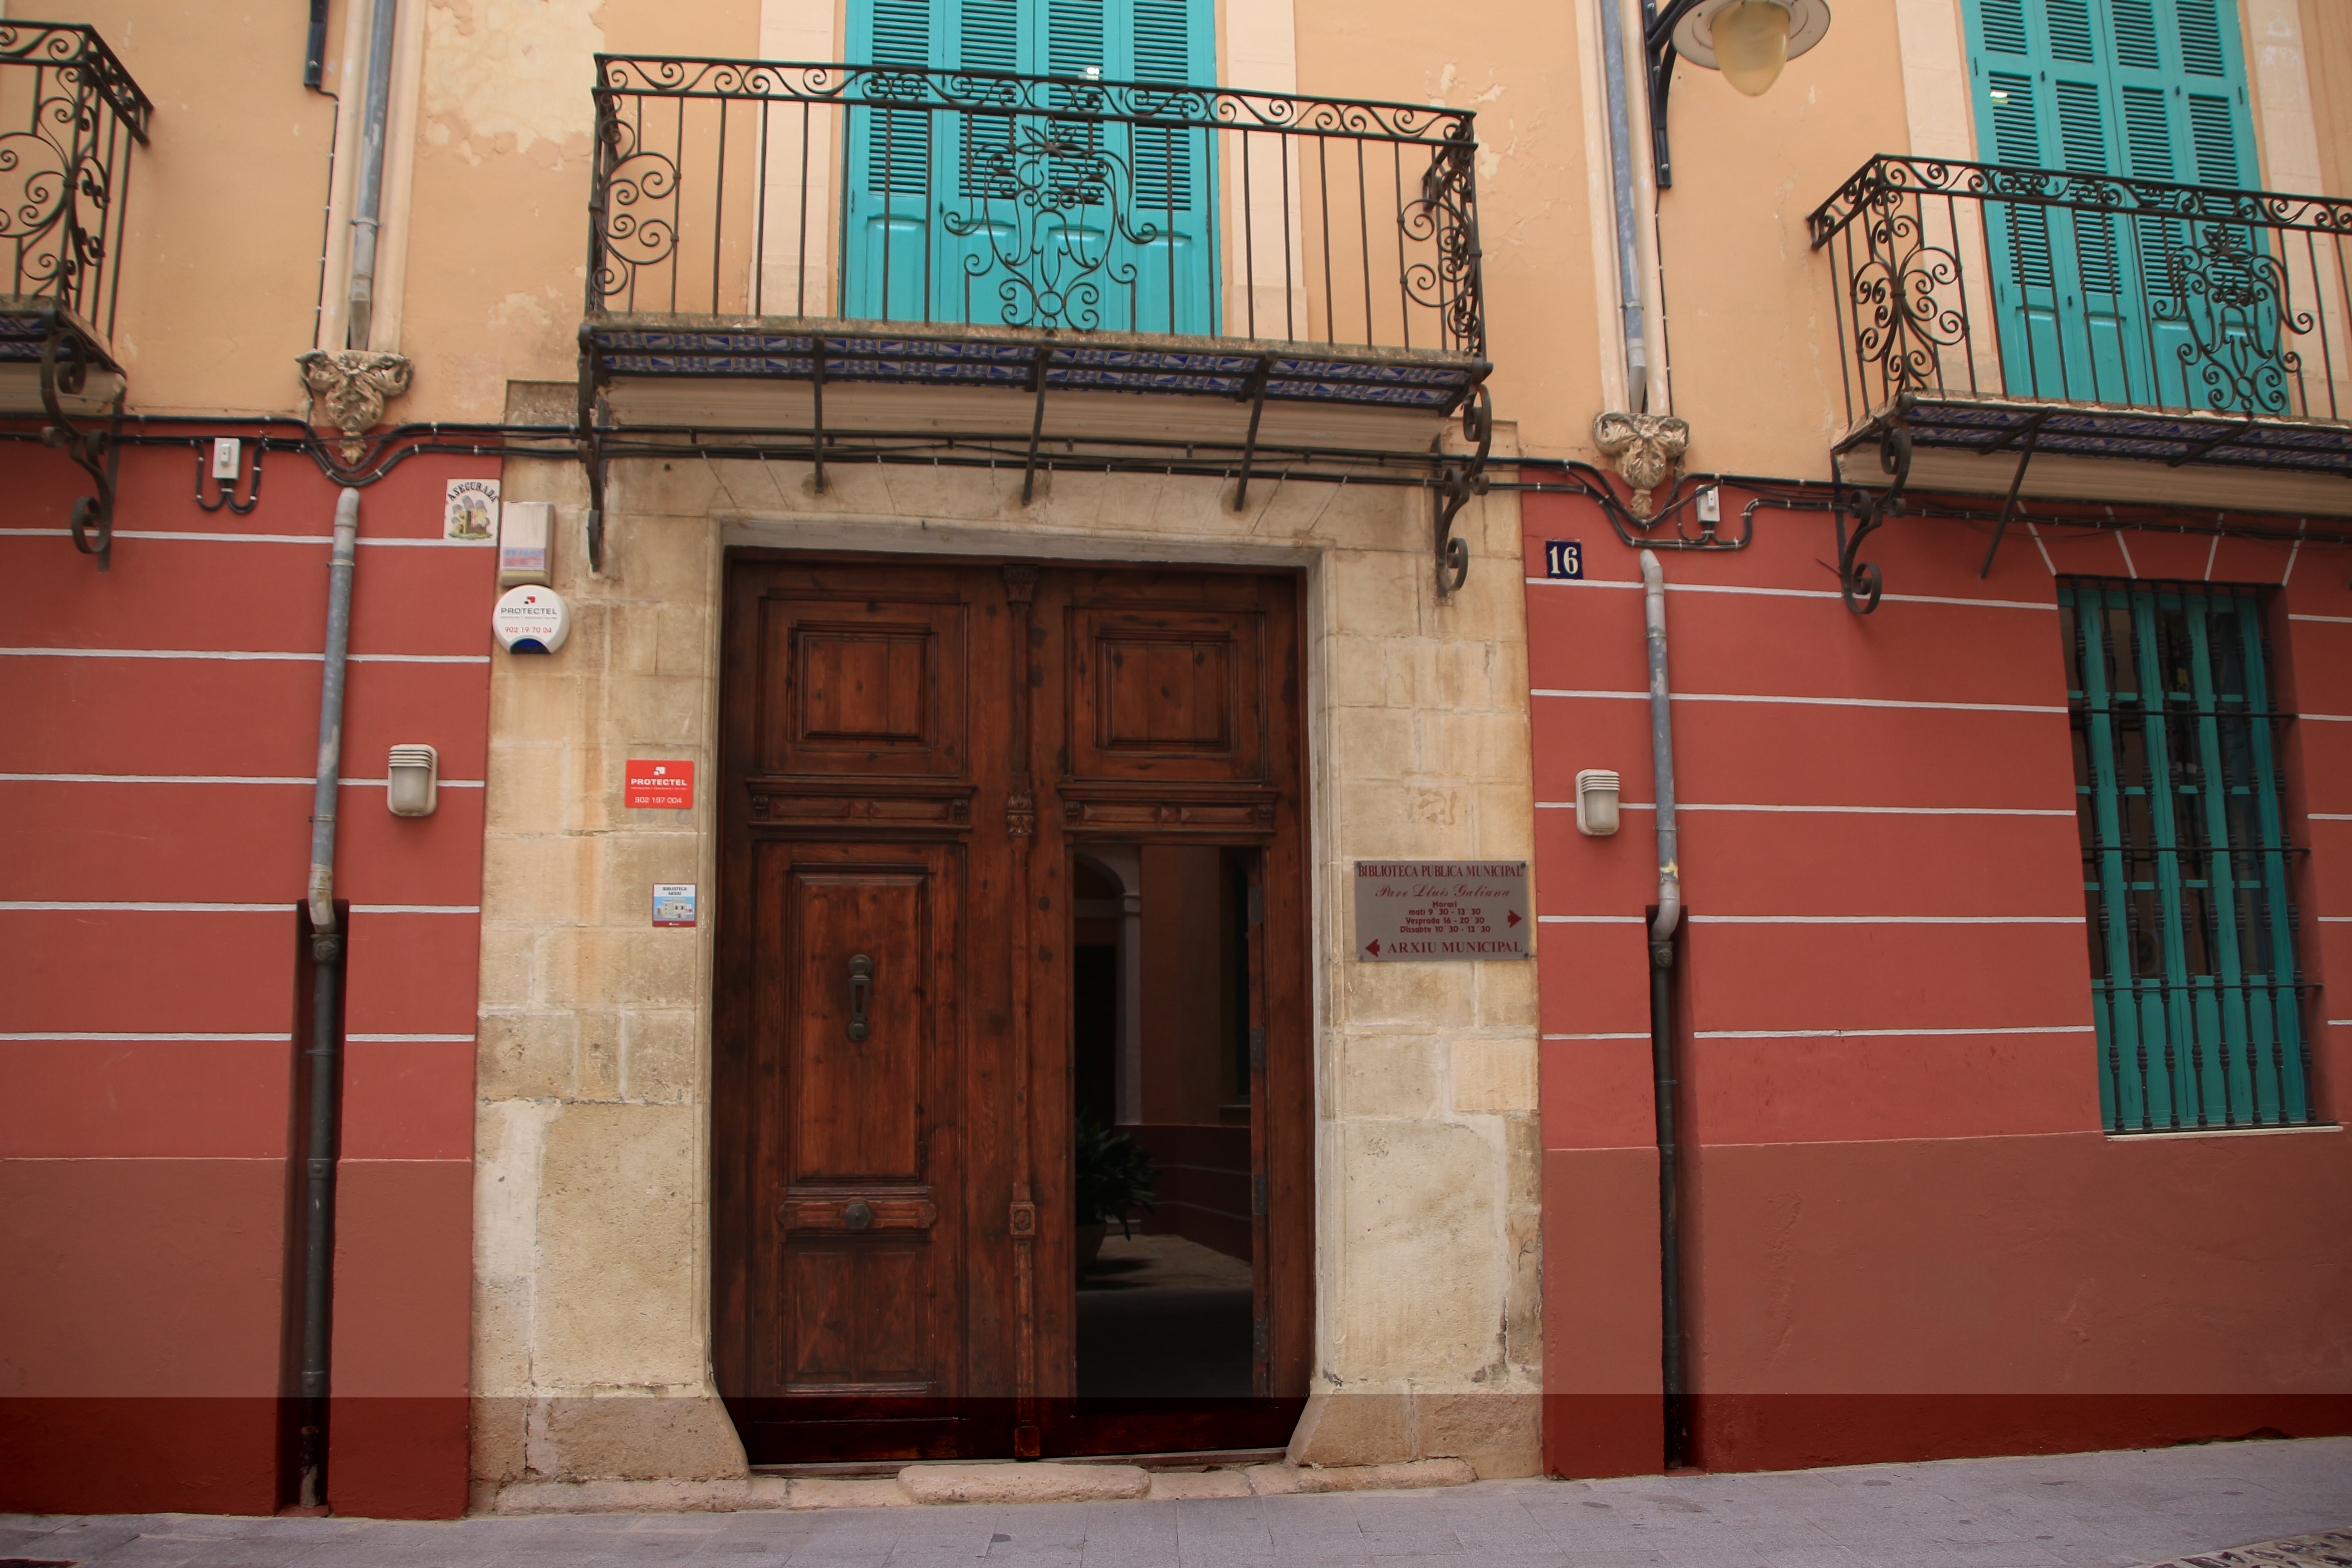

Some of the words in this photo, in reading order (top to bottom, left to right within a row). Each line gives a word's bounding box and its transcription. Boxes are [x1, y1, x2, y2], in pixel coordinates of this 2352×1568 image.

[447, 481, 499, 502] ASEGURADA
[1549, 546, 1579, 574] 16
[1358, 865, 1418, 877] BIBLIOTECA
[1421, 865, 1463, 877] PUBLICA
[1466, 865, 1523, 877] MUNICIPAL
[1375, 884, 1408, 897] Pare
[1413, 884, 1449, 897] Lluis
[1453, 884, 1510, 897] Galiana
[1406, 917, 1440, 925] Vesprada
[1387, 941, 1437, 953] ARXIU
[1442, 941, 1523, 953] MUNICIPAL
